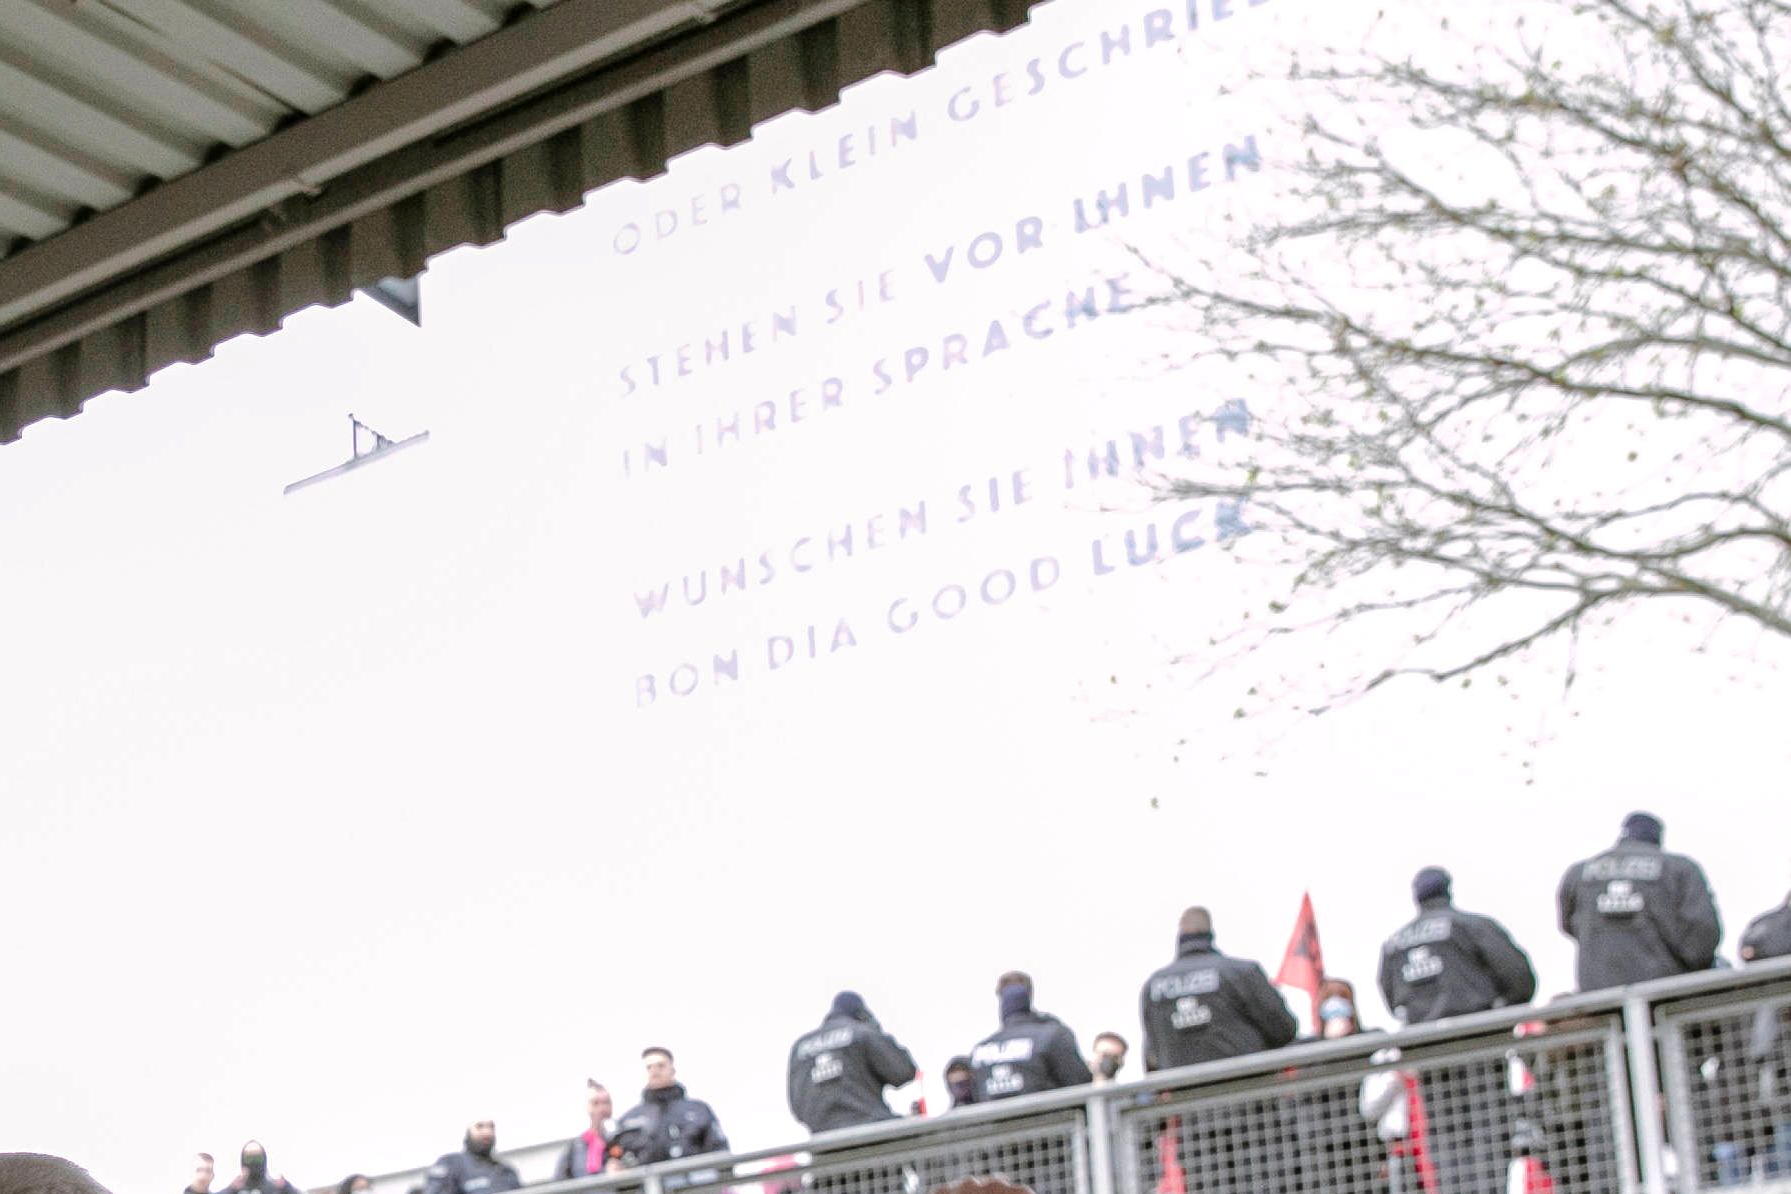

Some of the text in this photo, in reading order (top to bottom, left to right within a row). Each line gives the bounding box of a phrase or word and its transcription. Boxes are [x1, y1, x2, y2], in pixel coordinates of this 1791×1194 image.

[613, 183, 742, 255] ODER
[770, 111, 918, 194] KLEIN
[620, 135, 1260, 397] STEHEN SIE VOR IHNEN
[622, 272, 1131, 478] IN IHRER SPRACHE
[958, 468, 1034, 521] SIE
[635, 649, 739, 708] BON
[767, 618, 857, 669] DIA
[888, 556, 1060, 634] GOOD
